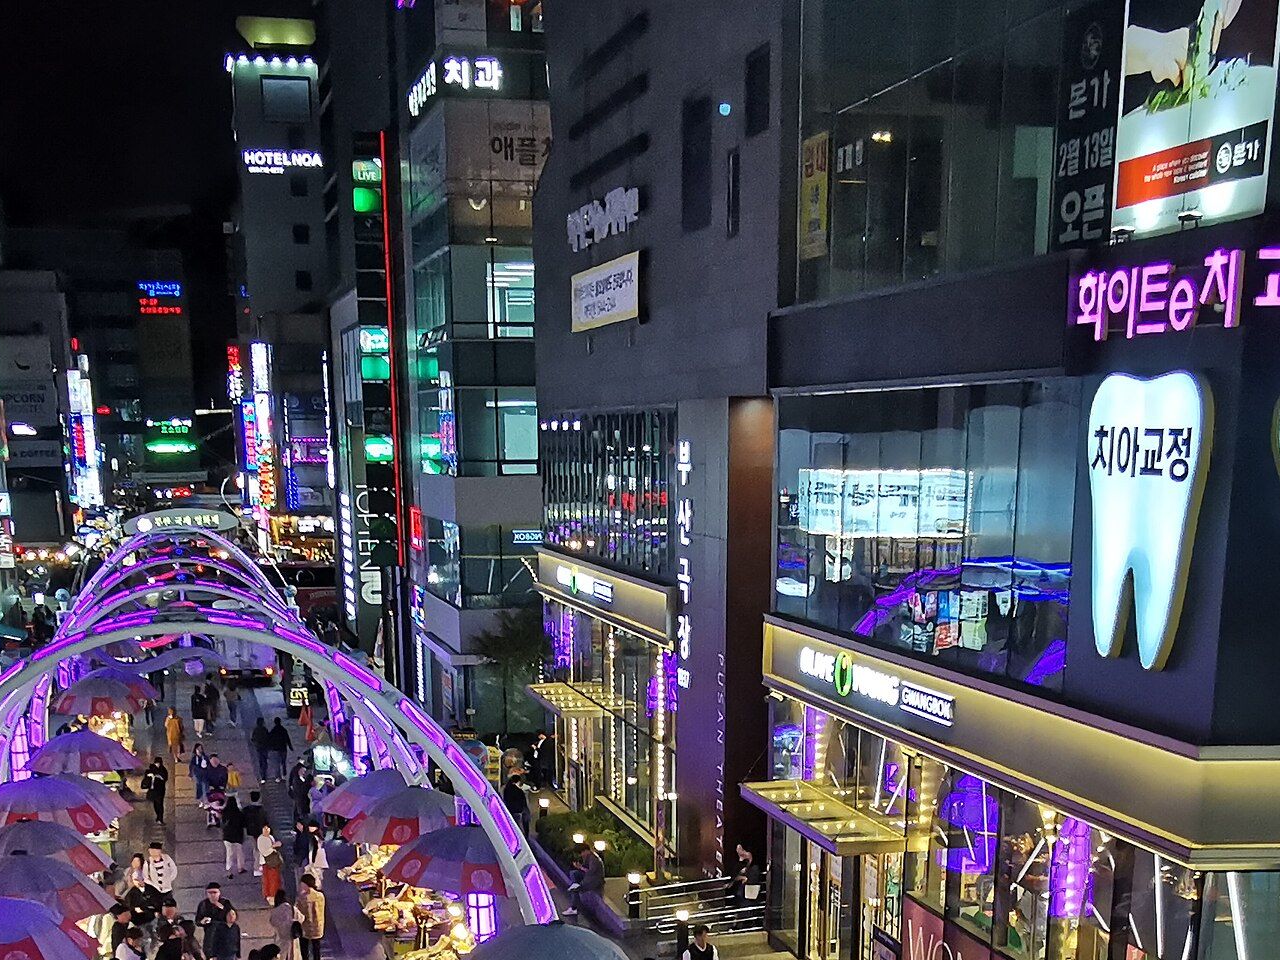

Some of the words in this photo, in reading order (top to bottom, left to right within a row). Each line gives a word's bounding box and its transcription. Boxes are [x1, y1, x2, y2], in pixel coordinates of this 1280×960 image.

[444, 57, 503, 91] 치과
[1058, 136, 1081, 178] 2월
[1084, 125, 1115, 170] 13일
[1091, 424, 1192, 484] 치아교정
